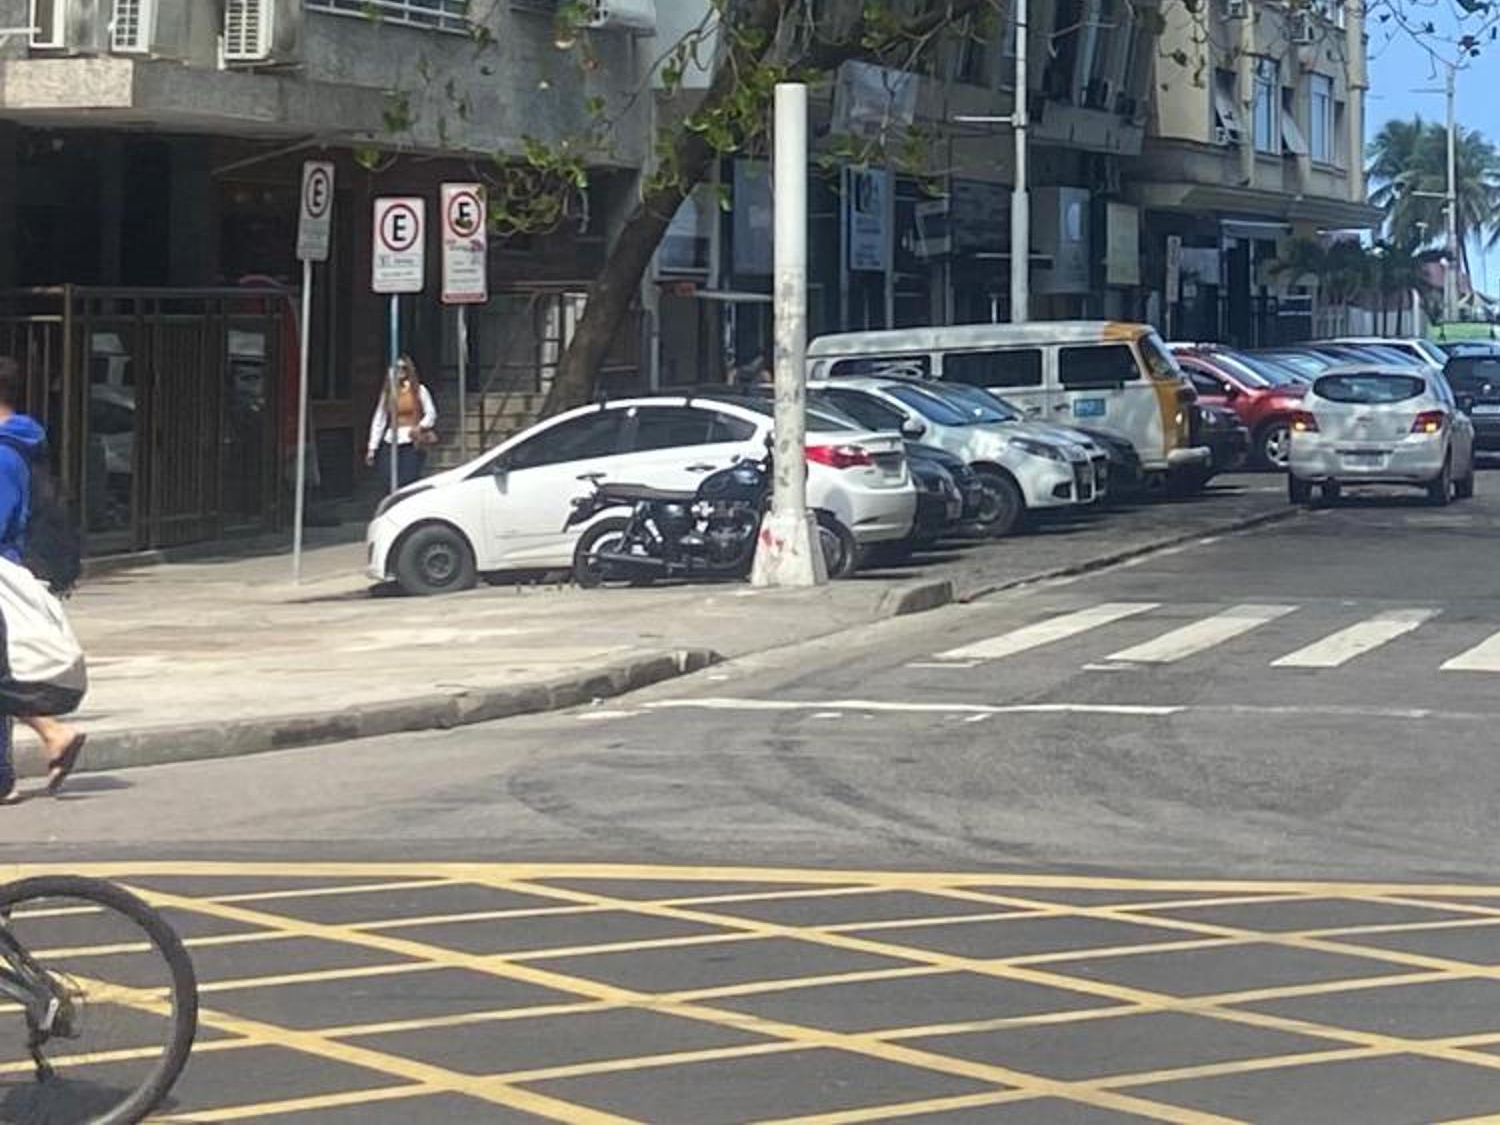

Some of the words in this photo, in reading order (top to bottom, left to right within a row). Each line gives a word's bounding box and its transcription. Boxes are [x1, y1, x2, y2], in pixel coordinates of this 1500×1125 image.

[313, 178, 323, 207] E
[392, 214, 407, 242] E
[458, 202, 472, 228] E
